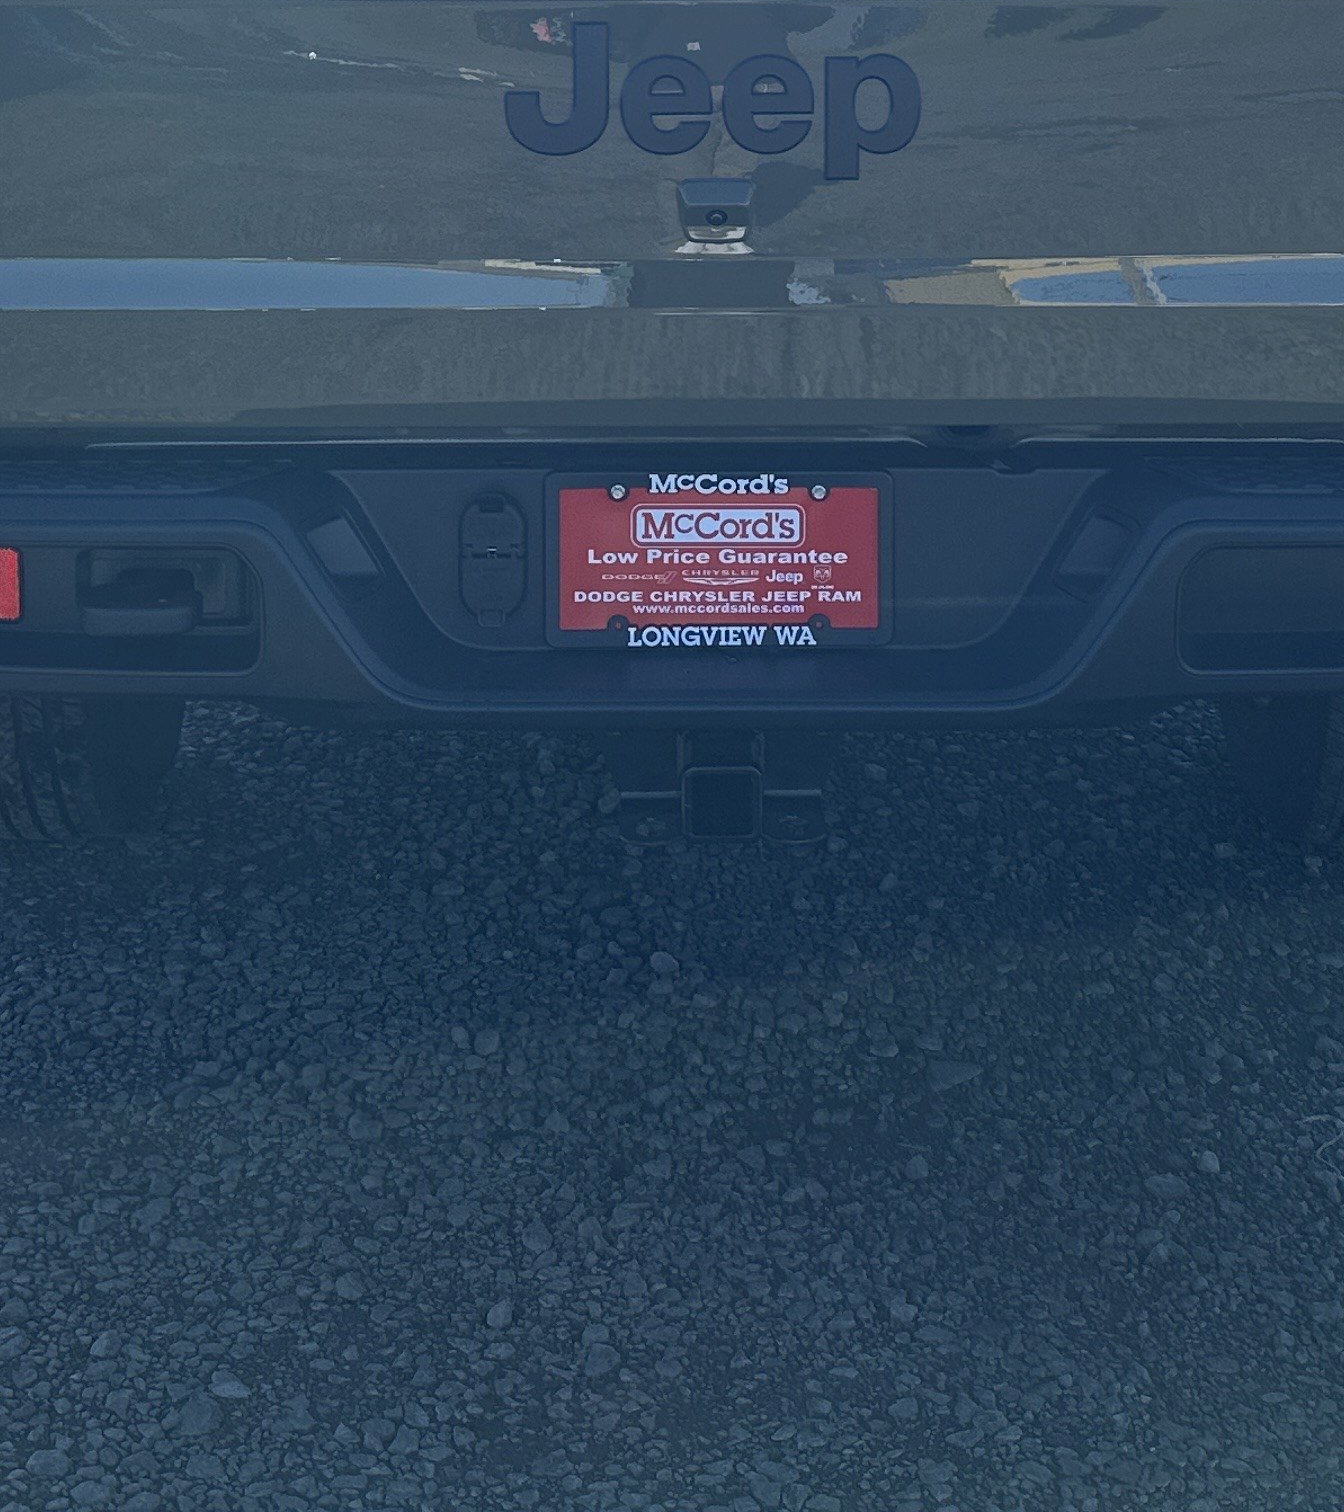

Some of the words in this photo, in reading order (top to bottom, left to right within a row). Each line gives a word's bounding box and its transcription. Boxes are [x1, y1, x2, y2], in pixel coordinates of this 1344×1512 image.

[503, 20, 923, 181] Jeep
[648, 473, 790, 496] McCord's
[640, 512, 796, 540] McCord's
[587, 549, 638, 564] Low
[646, 548, 710, 564] Price
[717, 549, 849, 565] Guarantee
[681, 569, 760, 577] CHRYSLER
[765, 569, 804, 585] Jeep
[573, 590, 643, 603] DODGE
[649, 590, 756, 603] CHRYSLER
[761, 590, 812, 603] JEEP
[817, 590, 862, 603] RAM
[632, 602, 805, 615] www.mccordsales.com
[627, 626, 767, 648] LONGVIEW
[773, 625, 817, 646] WA
